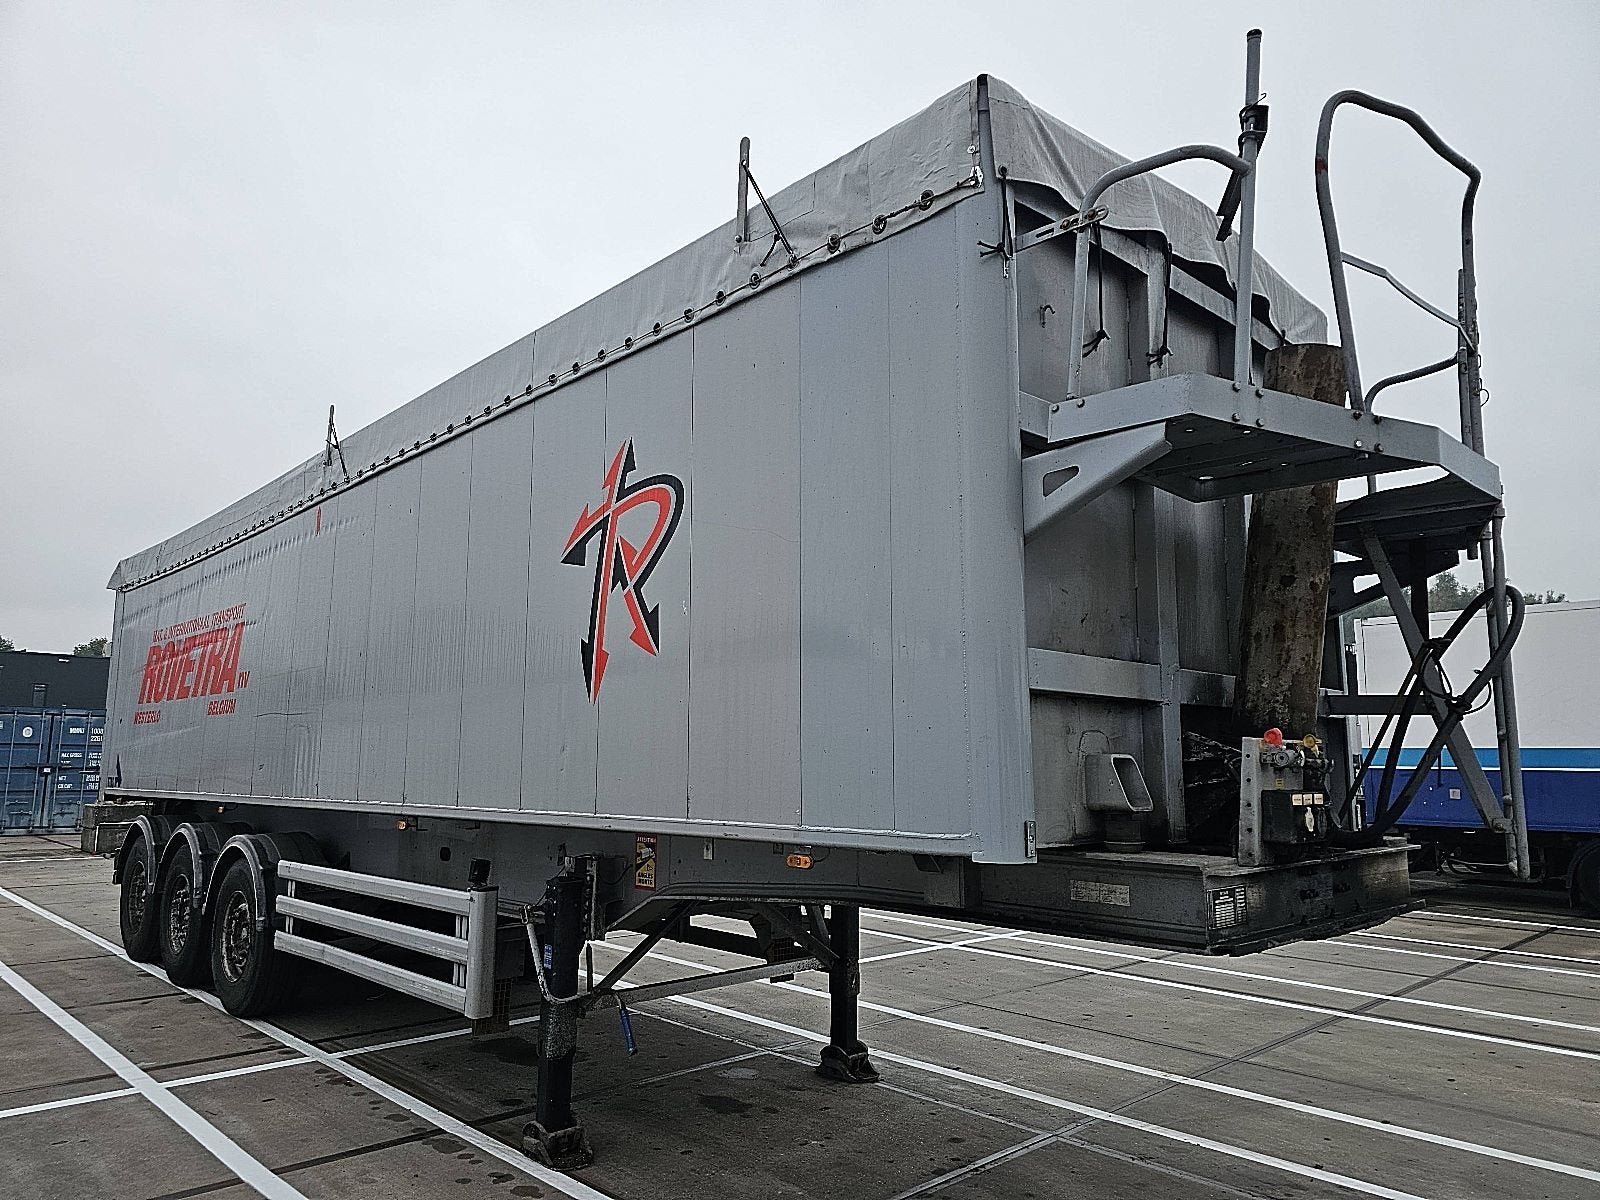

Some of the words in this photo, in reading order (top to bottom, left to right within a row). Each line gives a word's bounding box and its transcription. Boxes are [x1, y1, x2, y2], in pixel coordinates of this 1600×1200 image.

[138, 622, 245, 704] ROVETRA
[207, 698, 237, 716] BELGIUM
[637, 871, 653, 879] ANGLES
[638, 878, 653, 886] MORTS
